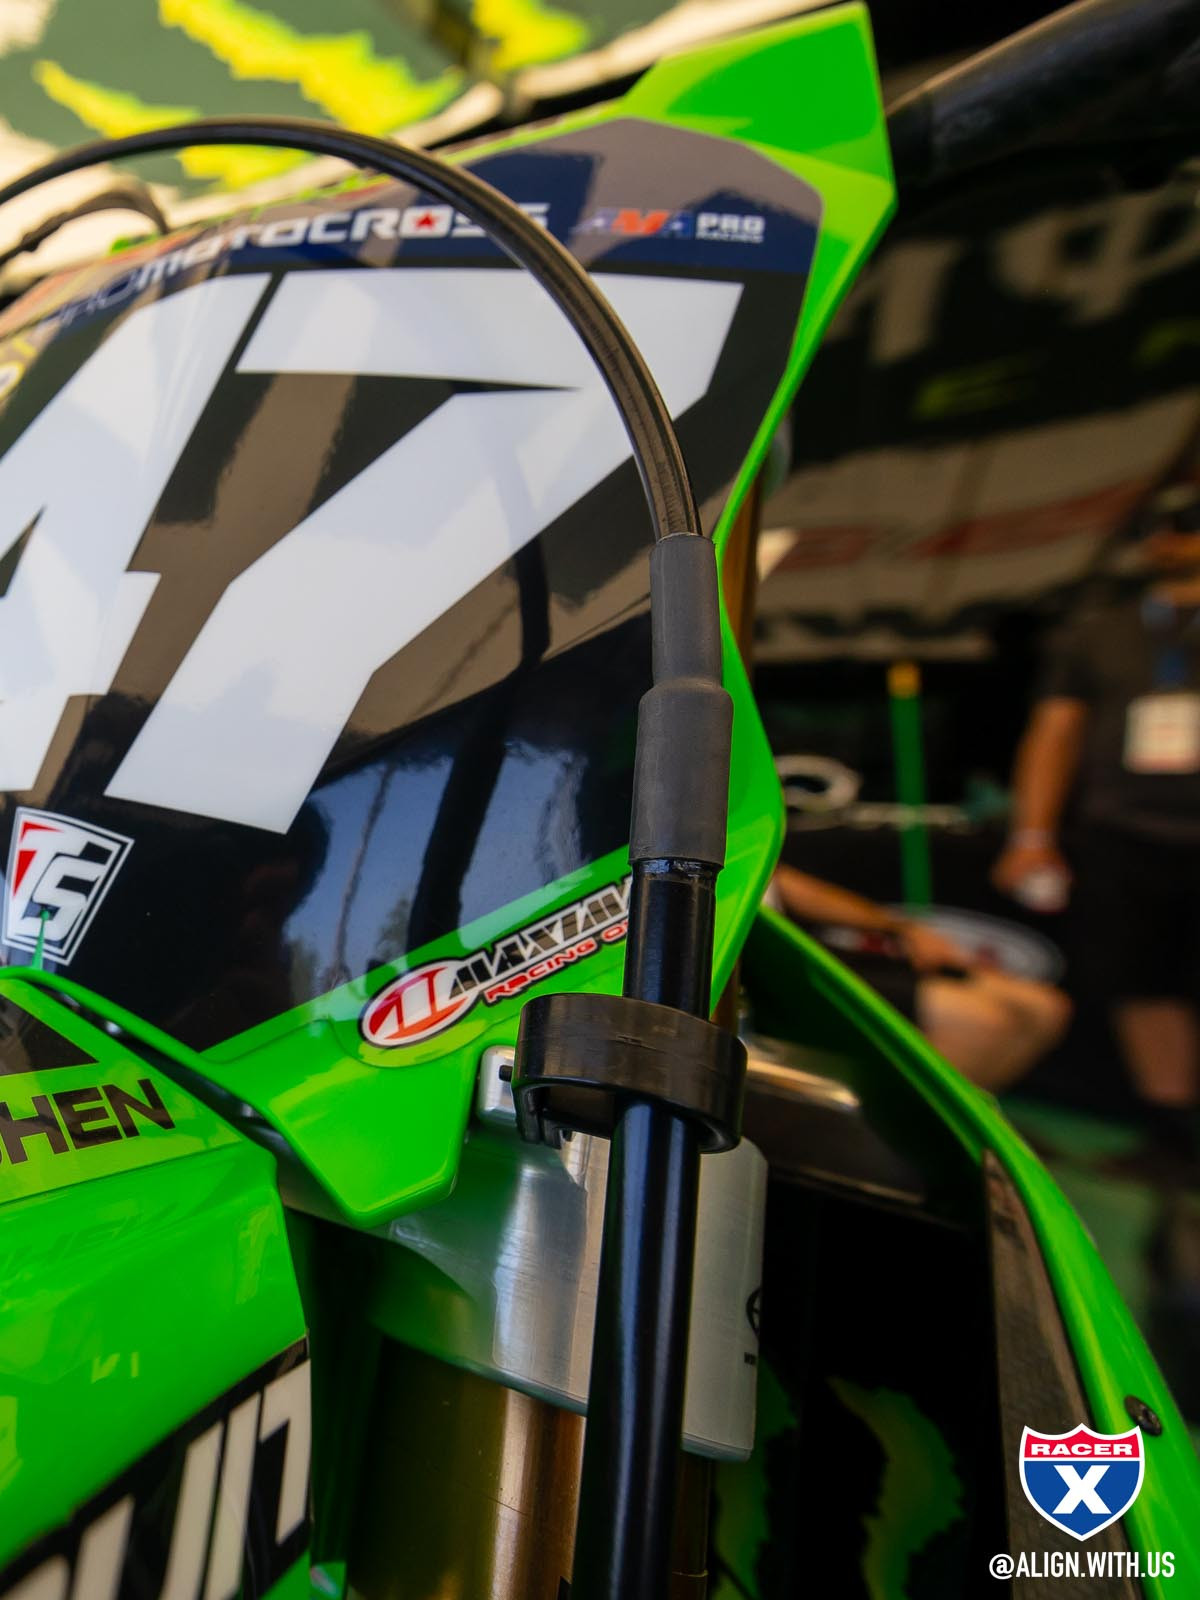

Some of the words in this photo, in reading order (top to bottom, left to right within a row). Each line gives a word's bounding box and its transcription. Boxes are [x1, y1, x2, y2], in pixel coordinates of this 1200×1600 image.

[696, 212, 765, 233] PRO
[450, 877, 632, 1000] MAXIM
[484, 938, 597, 1003] RACING
